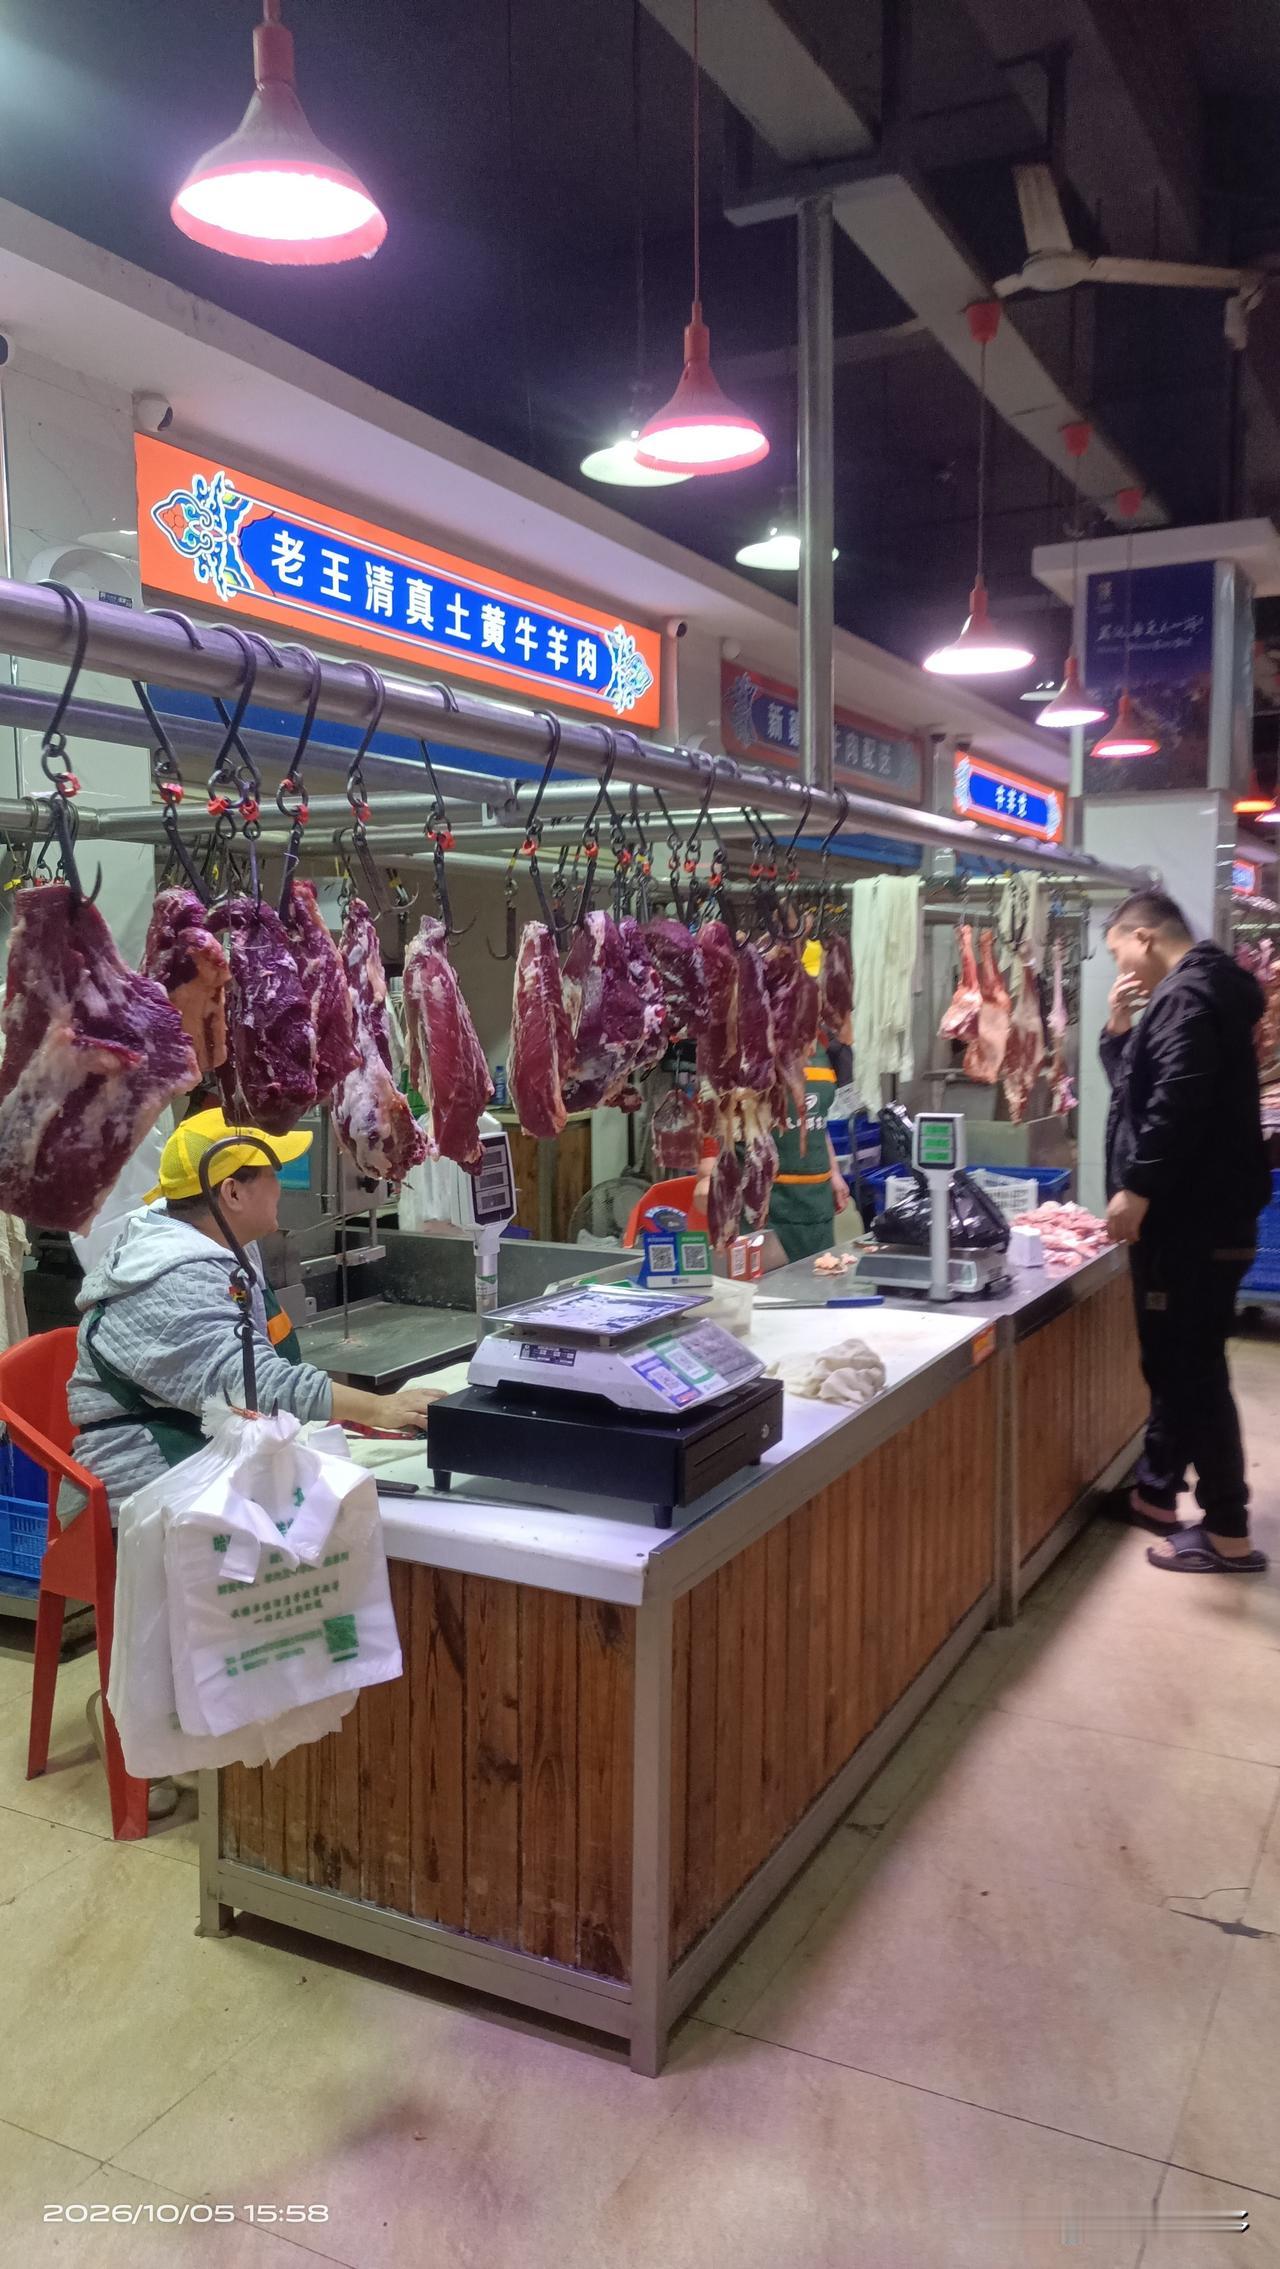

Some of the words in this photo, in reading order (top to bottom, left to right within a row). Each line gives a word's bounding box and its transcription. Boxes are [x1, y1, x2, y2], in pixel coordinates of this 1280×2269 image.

[270, 530, 598, 681] 老王清真土黄牛羊肉
